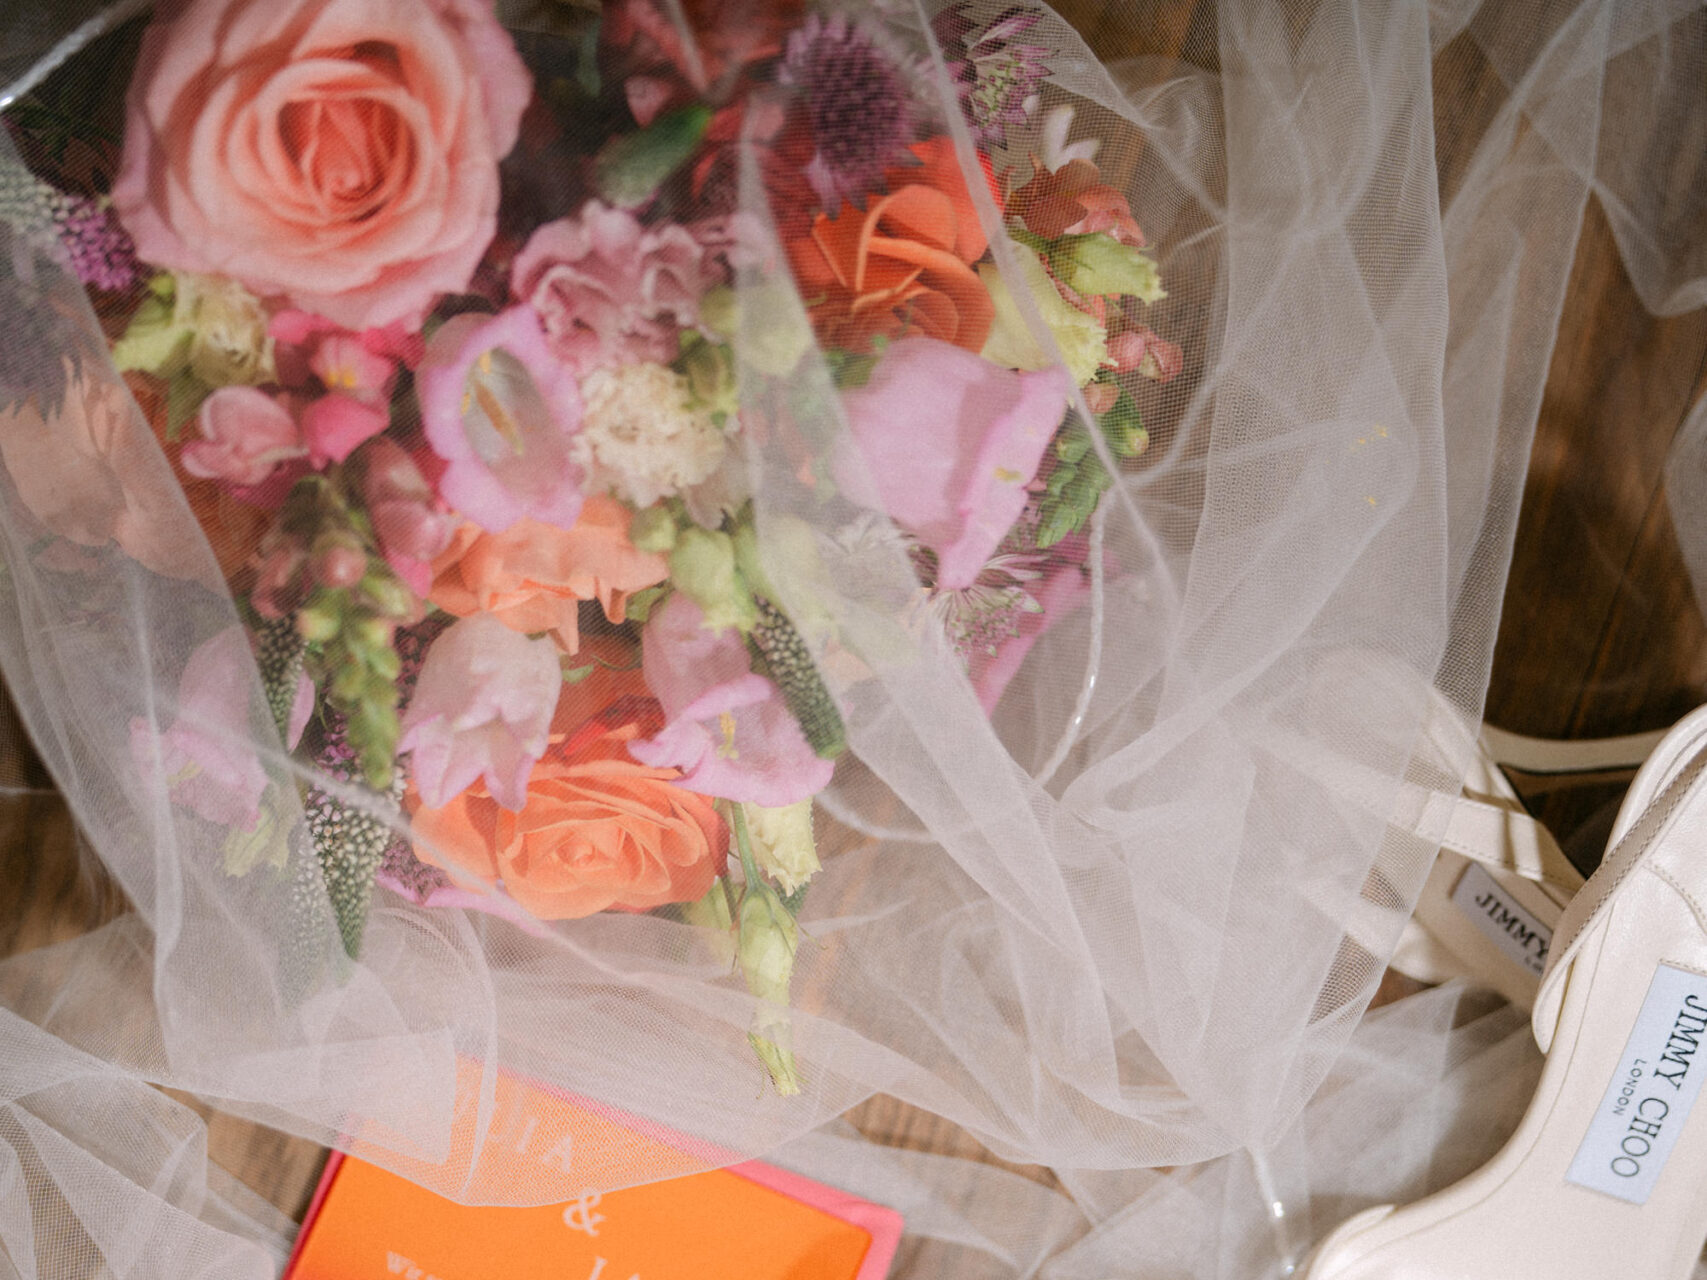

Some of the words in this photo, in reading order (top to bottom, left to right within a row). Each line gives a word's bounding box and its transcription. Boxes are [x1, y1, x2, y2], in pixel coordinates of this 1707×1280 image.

[1653, 994, 1707, 1091] JIMMY
[1613, 1058, 1647, 1116] LONDON
[1611, 1098, 1669, 1178] CHOO
